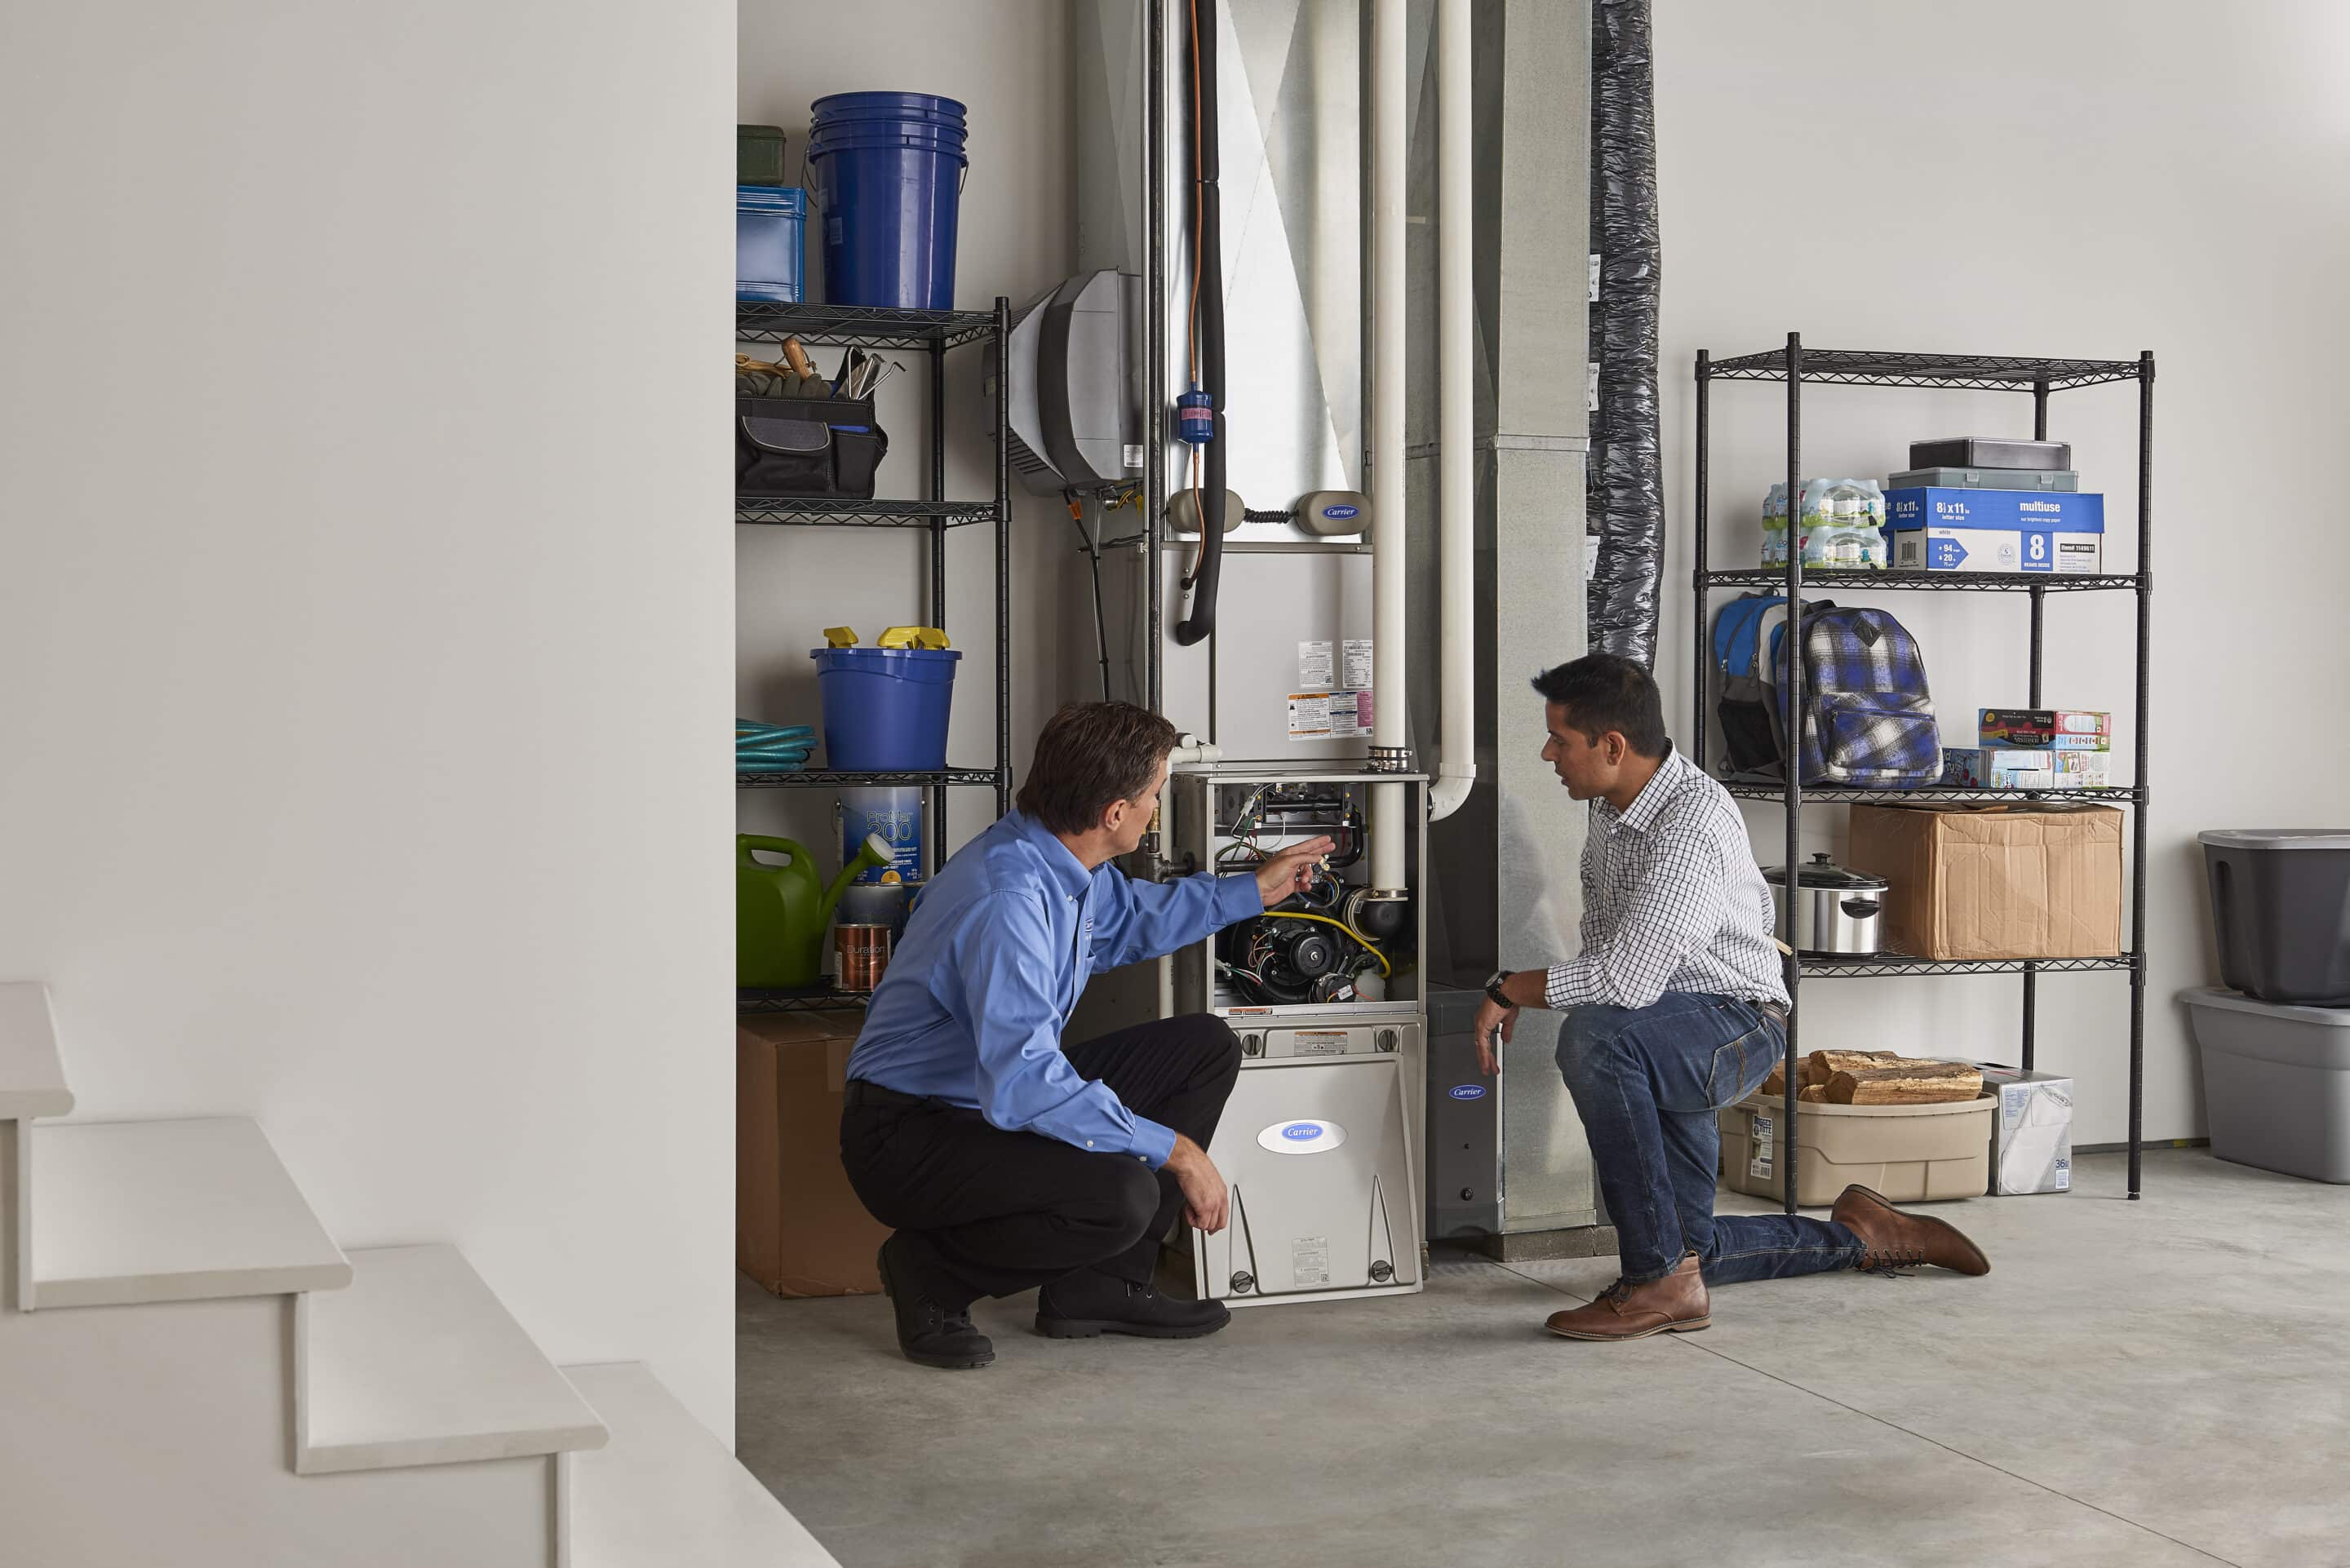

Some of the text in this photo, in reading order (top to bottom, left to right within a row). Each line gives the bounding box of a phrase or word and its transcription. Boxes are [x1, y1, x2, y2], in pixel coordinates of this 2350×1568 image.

[2020, 500, 2061, 512] multiuse
[1944, 544, 1953, 552] 94
[2030, 534, 2045, 560] 8
[1944, 554, 1953, 562] 20
[867, 822, 912, 841] 200
[846, 945, 885, 954] Duration
[1454, 1087, 1482, 1096] Carrier
[1288, 1127, 1319, 1136] Carrier
[2055, 1159, 2065, 1168] 36
